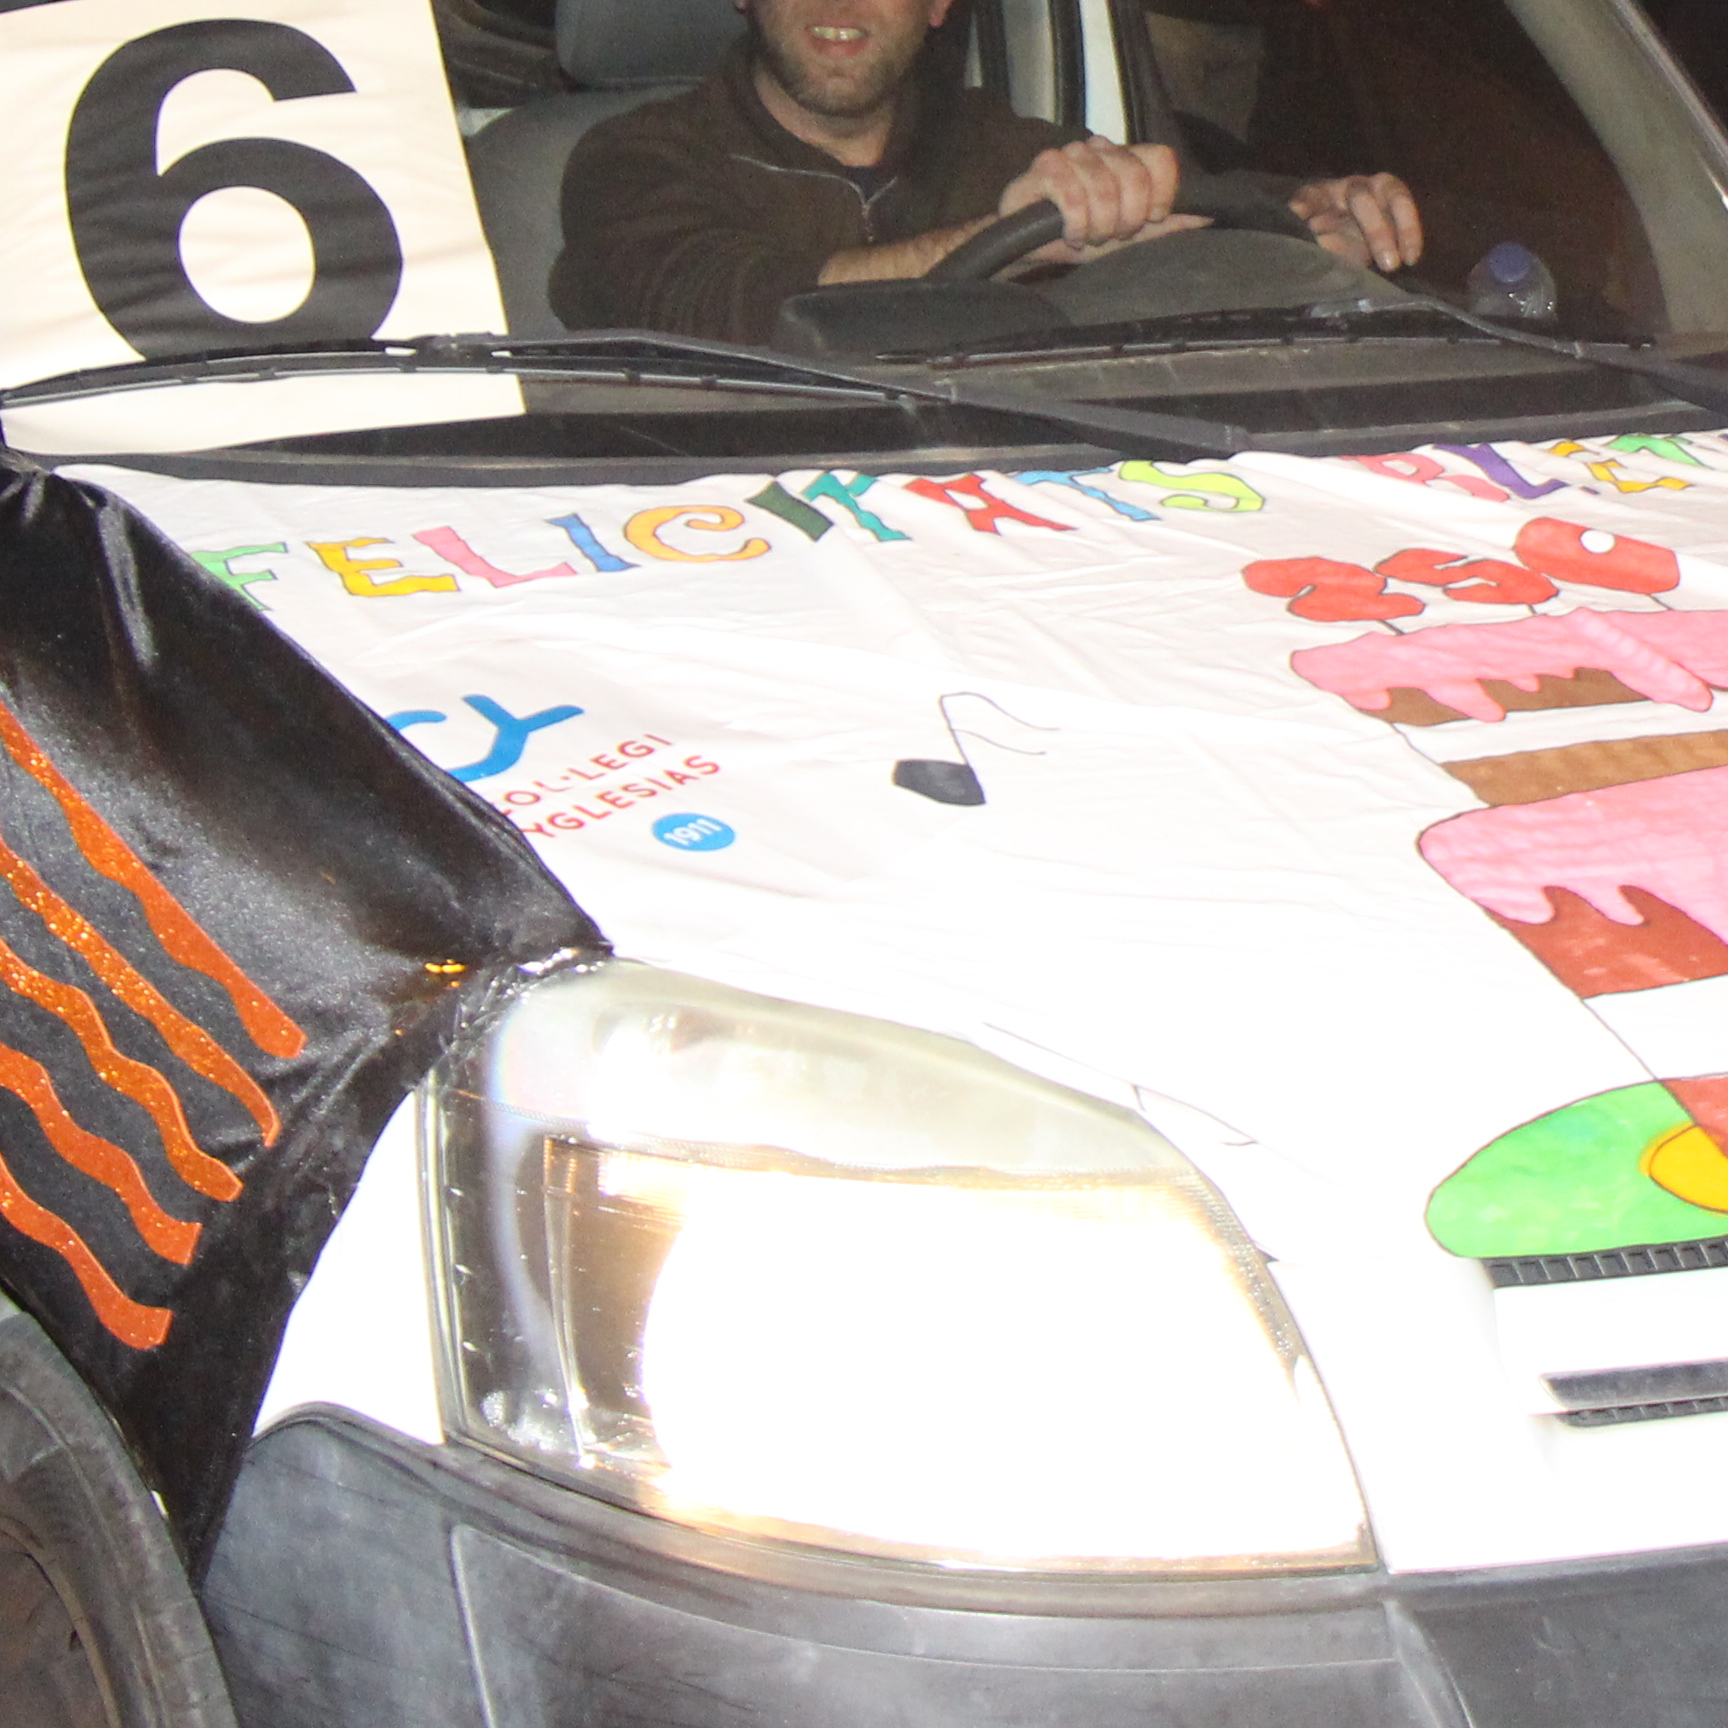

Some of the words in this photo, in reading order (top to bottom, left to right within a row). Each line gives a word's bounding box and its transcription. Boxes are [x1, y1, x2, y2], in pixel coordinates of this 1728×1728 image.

[64, 17, 404, 364] 6
[521, 753, 722, 841] YGLESIAS
[663, 817, 723, 847] 1911
